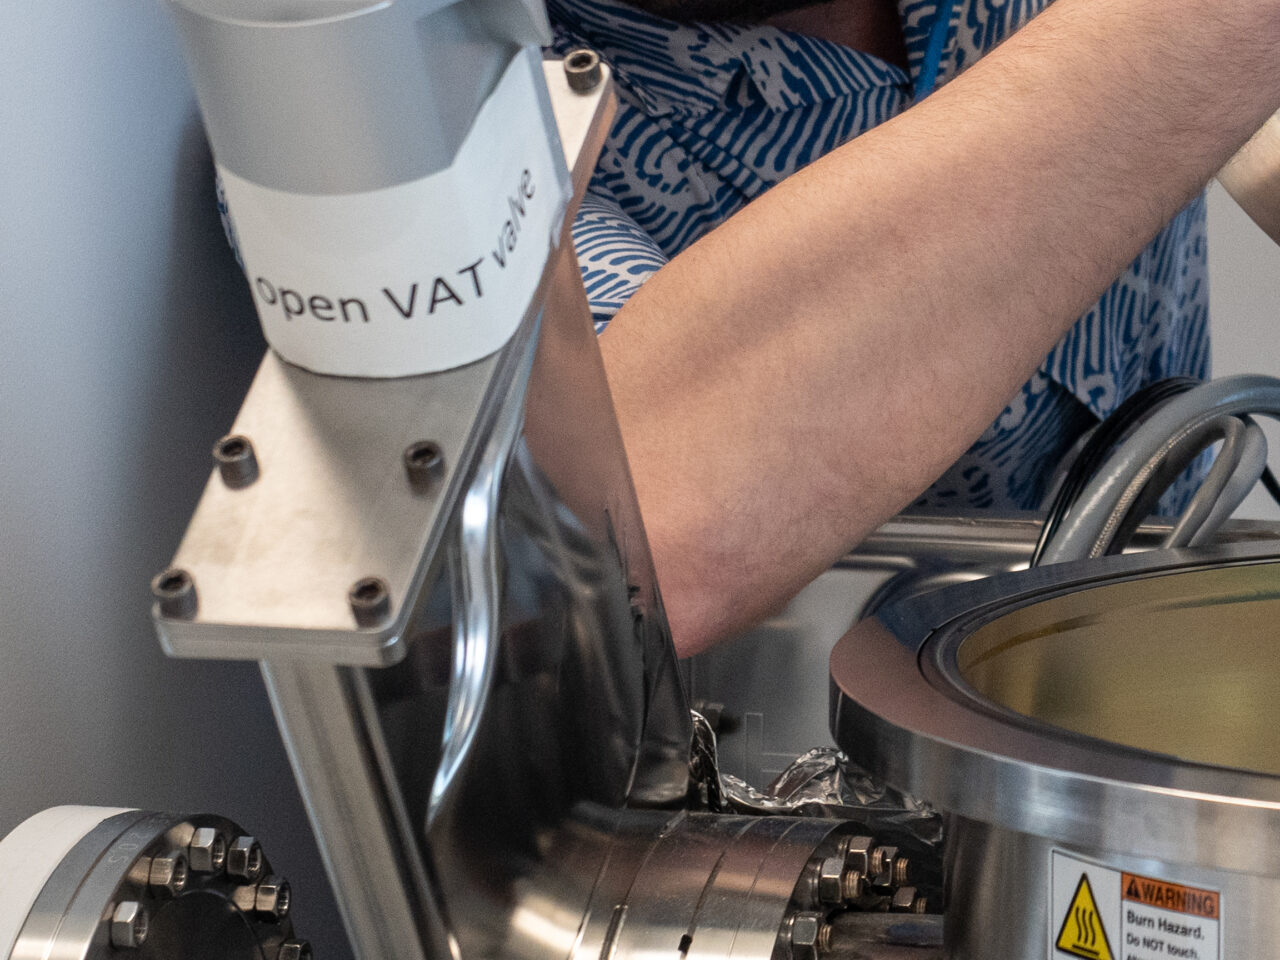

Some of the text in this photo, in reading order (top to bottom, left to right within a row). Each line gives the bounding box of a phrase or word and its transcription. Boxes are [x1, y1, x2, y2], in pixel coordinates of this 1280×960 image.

[381, 257, 485, 320] VAT
[491, 168, 536, 270] valve
[1141, 881, 1215, 915] WARNING
[1126, 909, 1205, 940] Burn Hazard.
[1126, 932, 1140, 947] Do
[1142, 935, 1165, 952] NOT
